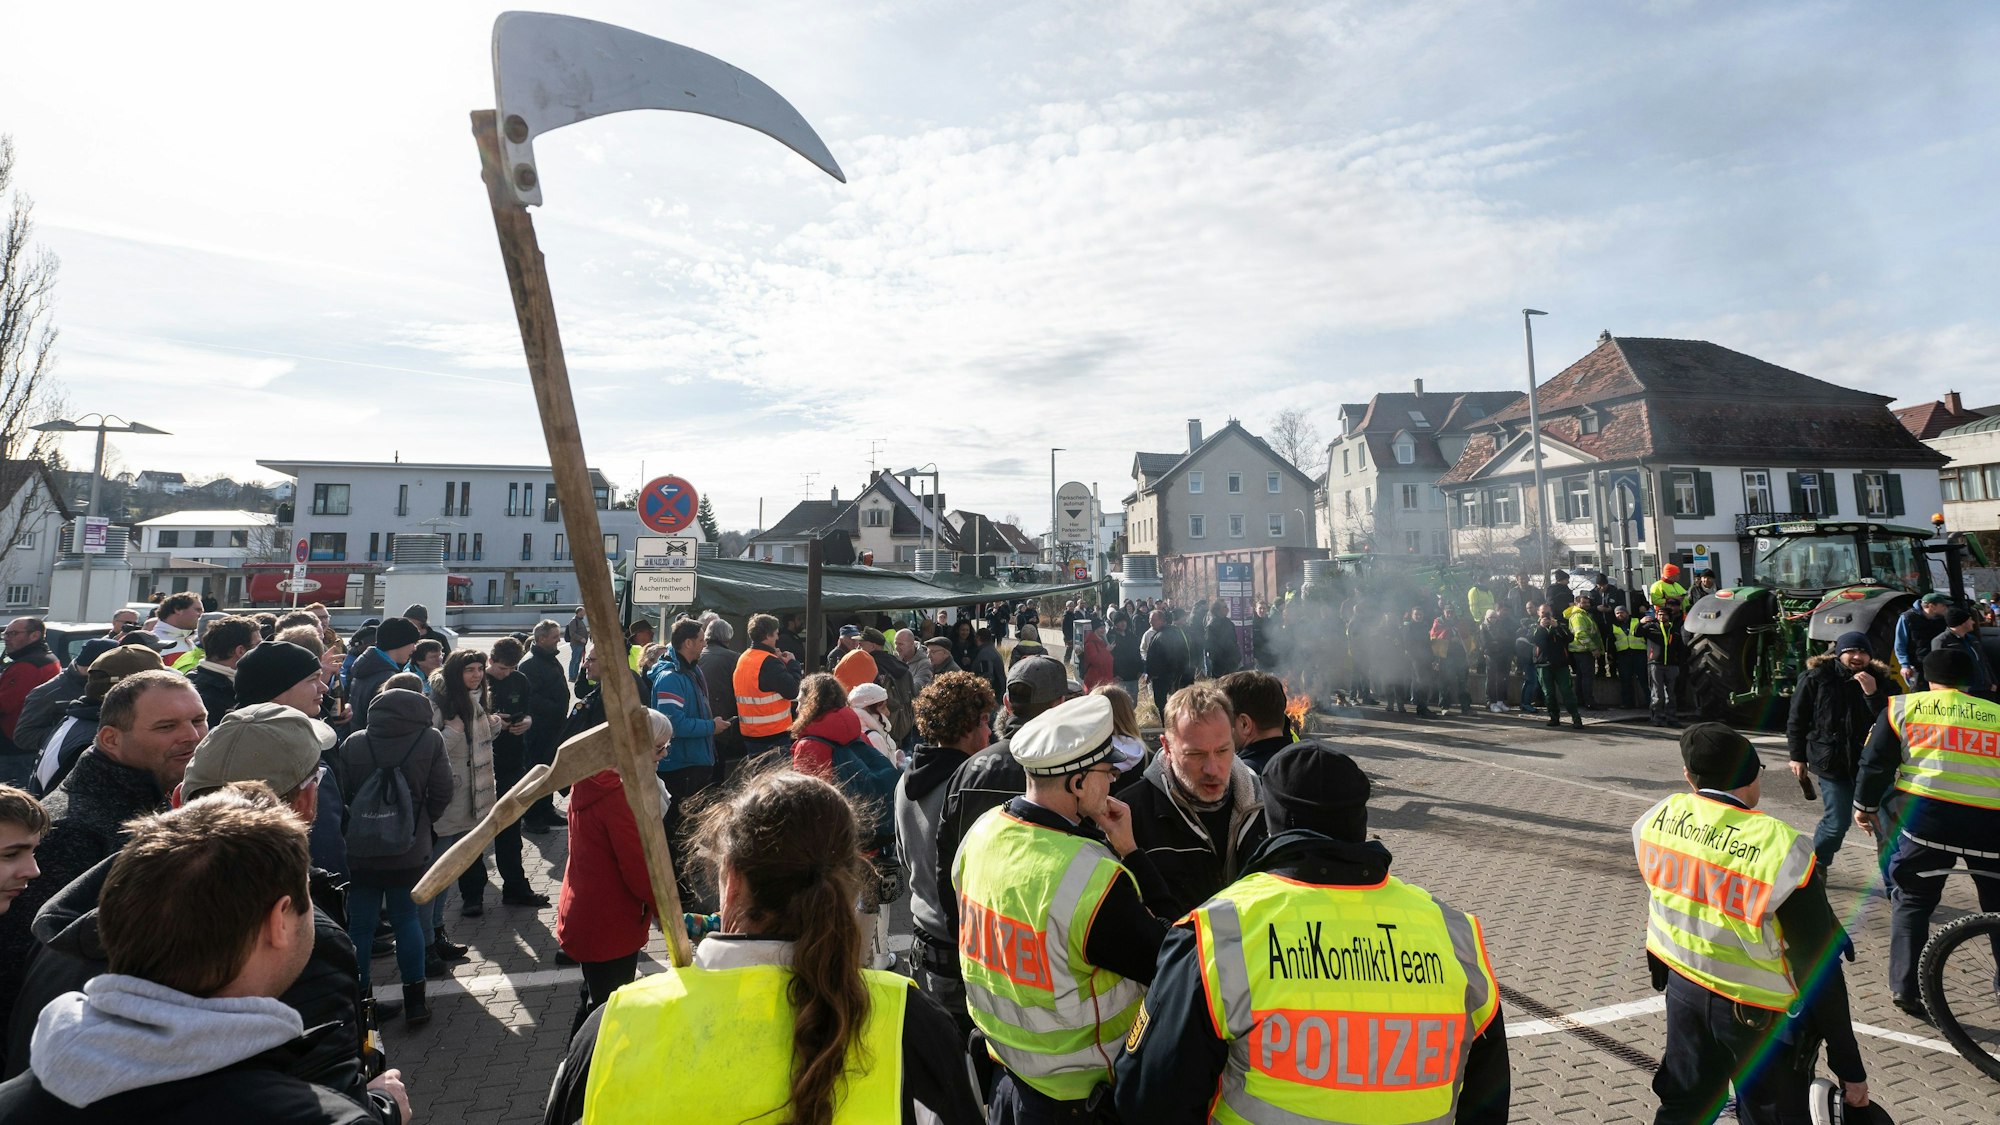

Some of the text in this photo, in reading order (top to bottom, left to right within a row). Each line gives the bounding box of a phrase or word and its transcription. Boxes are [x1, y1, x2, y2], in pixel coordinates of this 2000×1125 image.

[1226, 566, 1233, 575] P
[1759, 541, 1768, 550] 50
[1914, 698, 1997, 723] AntiKonfliktTeam
[1652, 805, 1761, 864] AntiKonfliktTeam
[1645, 845, 1760, 921] POLIZEI
[1268, 921, 1444, 984] AntiKonfliktTeam
[1261, 1012, 1456, 1086] POLIZEI
